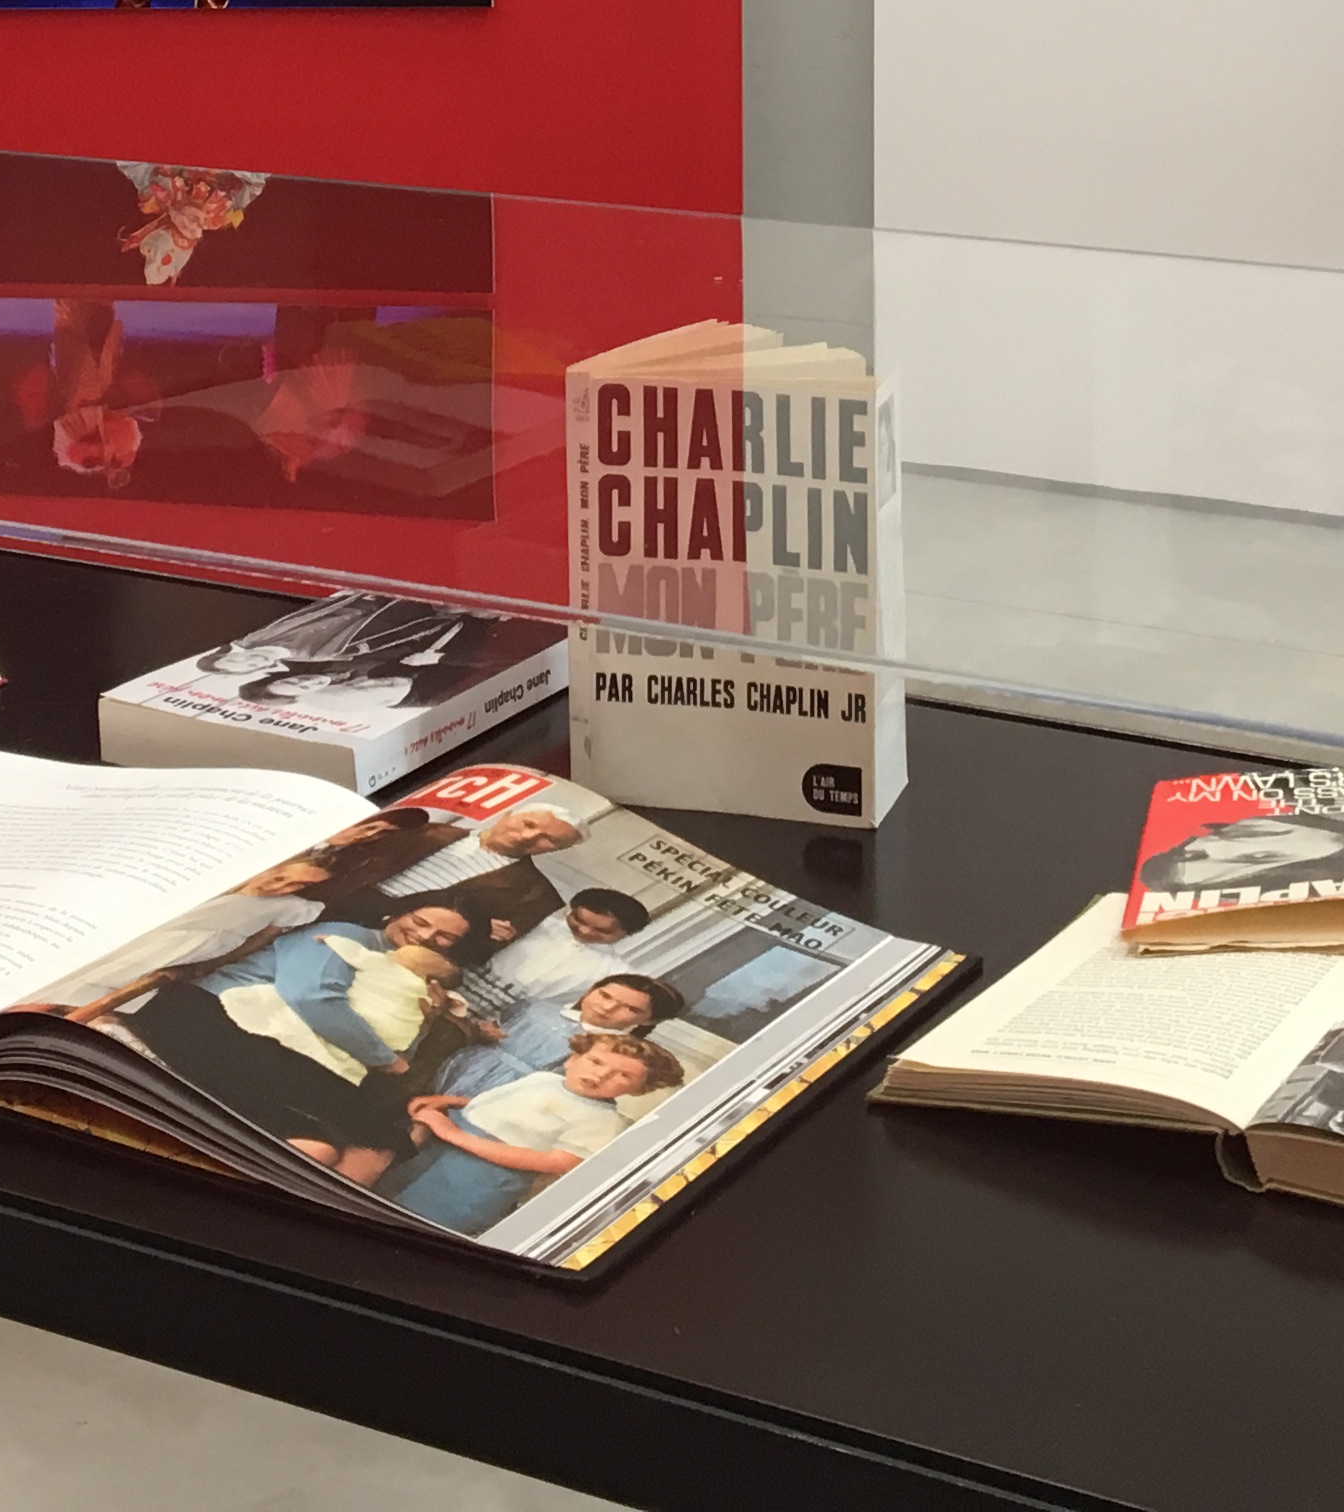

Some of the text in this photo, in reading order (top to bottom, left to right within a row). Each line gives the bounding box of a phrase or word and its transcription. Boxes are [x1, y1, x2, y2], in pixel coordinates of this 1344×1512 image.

[597, 382, 868, 484] CHARLIE
[597, 473, 868, 575] CHAPLIN
[595, 562, 717, 659] MON
[484, 685, 525, 714] Chaplin
[526, 669, 552, 692] Jane
[595, 672, 867, 723] PAR CHARLES CHAPLIN JR
[162, 695, 319, 734] Jane Chaplin
[812, 774, 836, 789] L'AIR
[812, 789, 859, 805] DU TEMPS
[1166, 790, 1222, 804] MY
[1232, 789, 1284, 801] ON
[627, 852, 700, 894] PÉKIN
[768, 922, 823, 950] MAO
[649, 839, 845, 937] SPÉCIAL COULEUR
